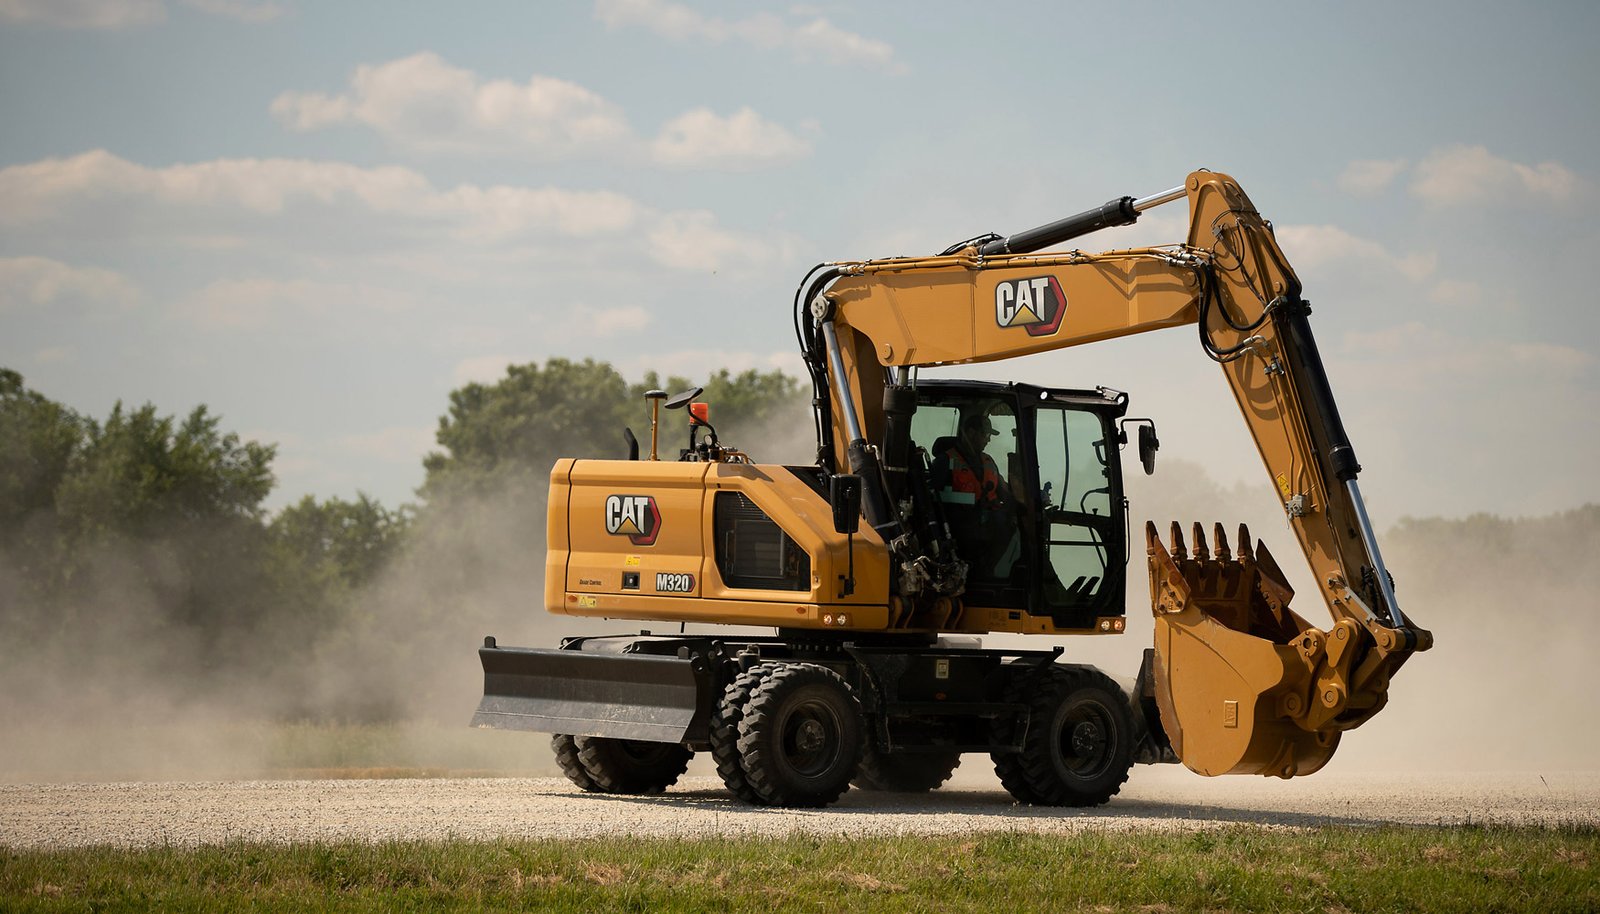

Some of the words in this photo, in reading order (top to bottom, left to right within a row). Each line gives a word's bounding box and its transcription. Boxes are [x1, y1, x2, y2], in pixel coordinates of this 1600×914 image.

[996, 277, 1049, 327] CAT
[606, 496, 649, 534] CAT
[656, 573, 689, 592] M320
